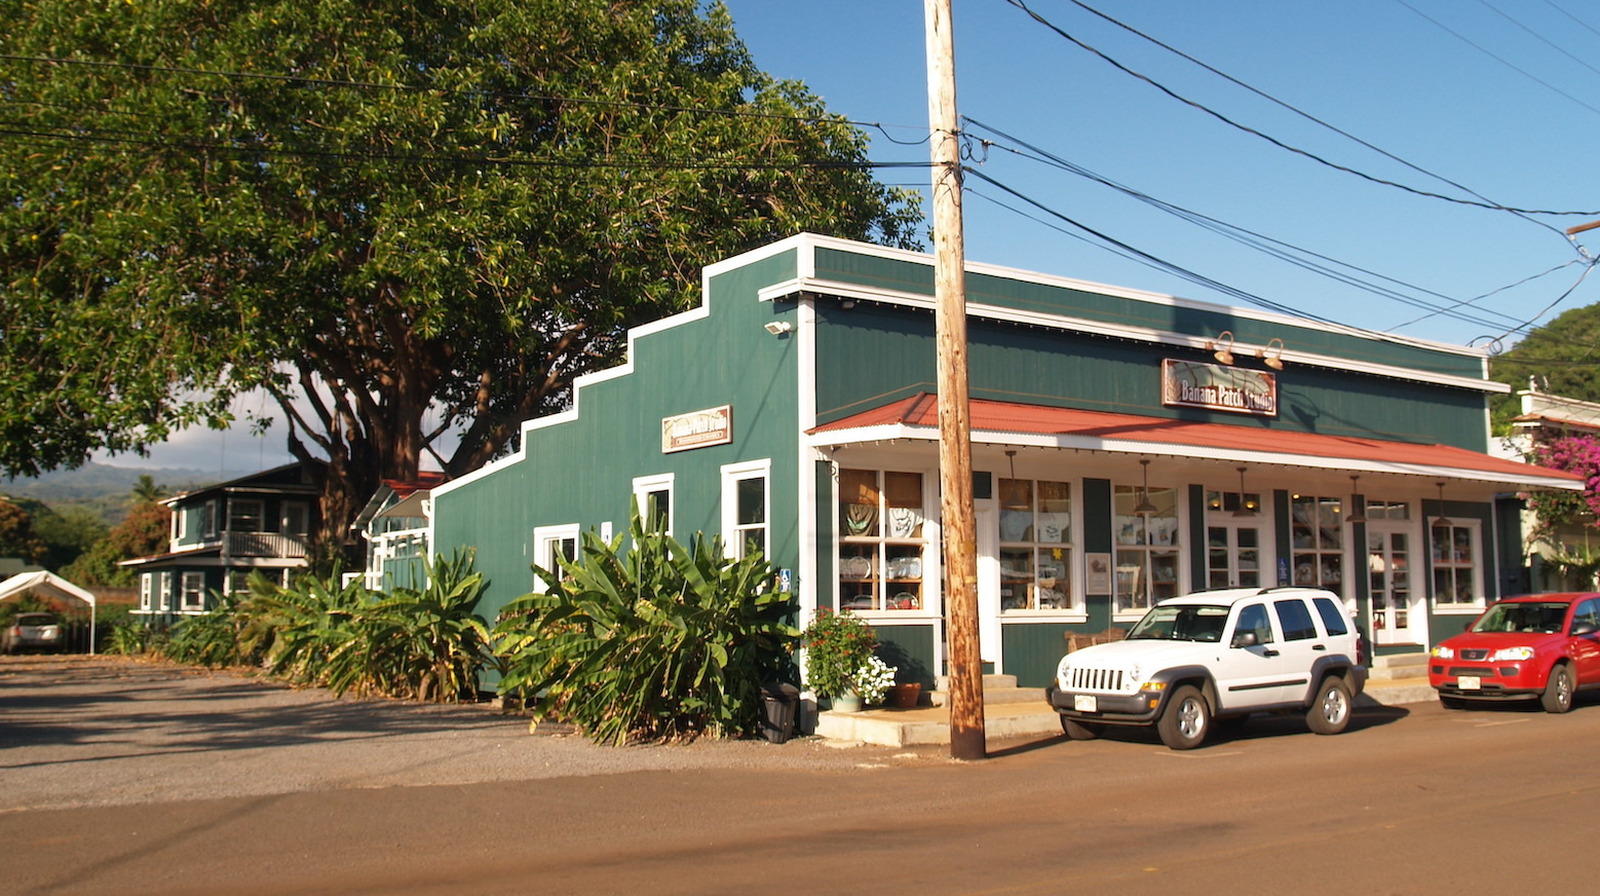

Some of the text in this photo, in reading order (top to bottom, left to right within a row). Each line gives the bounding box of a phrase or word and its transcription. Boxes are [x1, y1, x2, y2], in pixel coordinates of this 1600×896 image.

[1182, 380, 1272, 410] Banana Patch Studio
